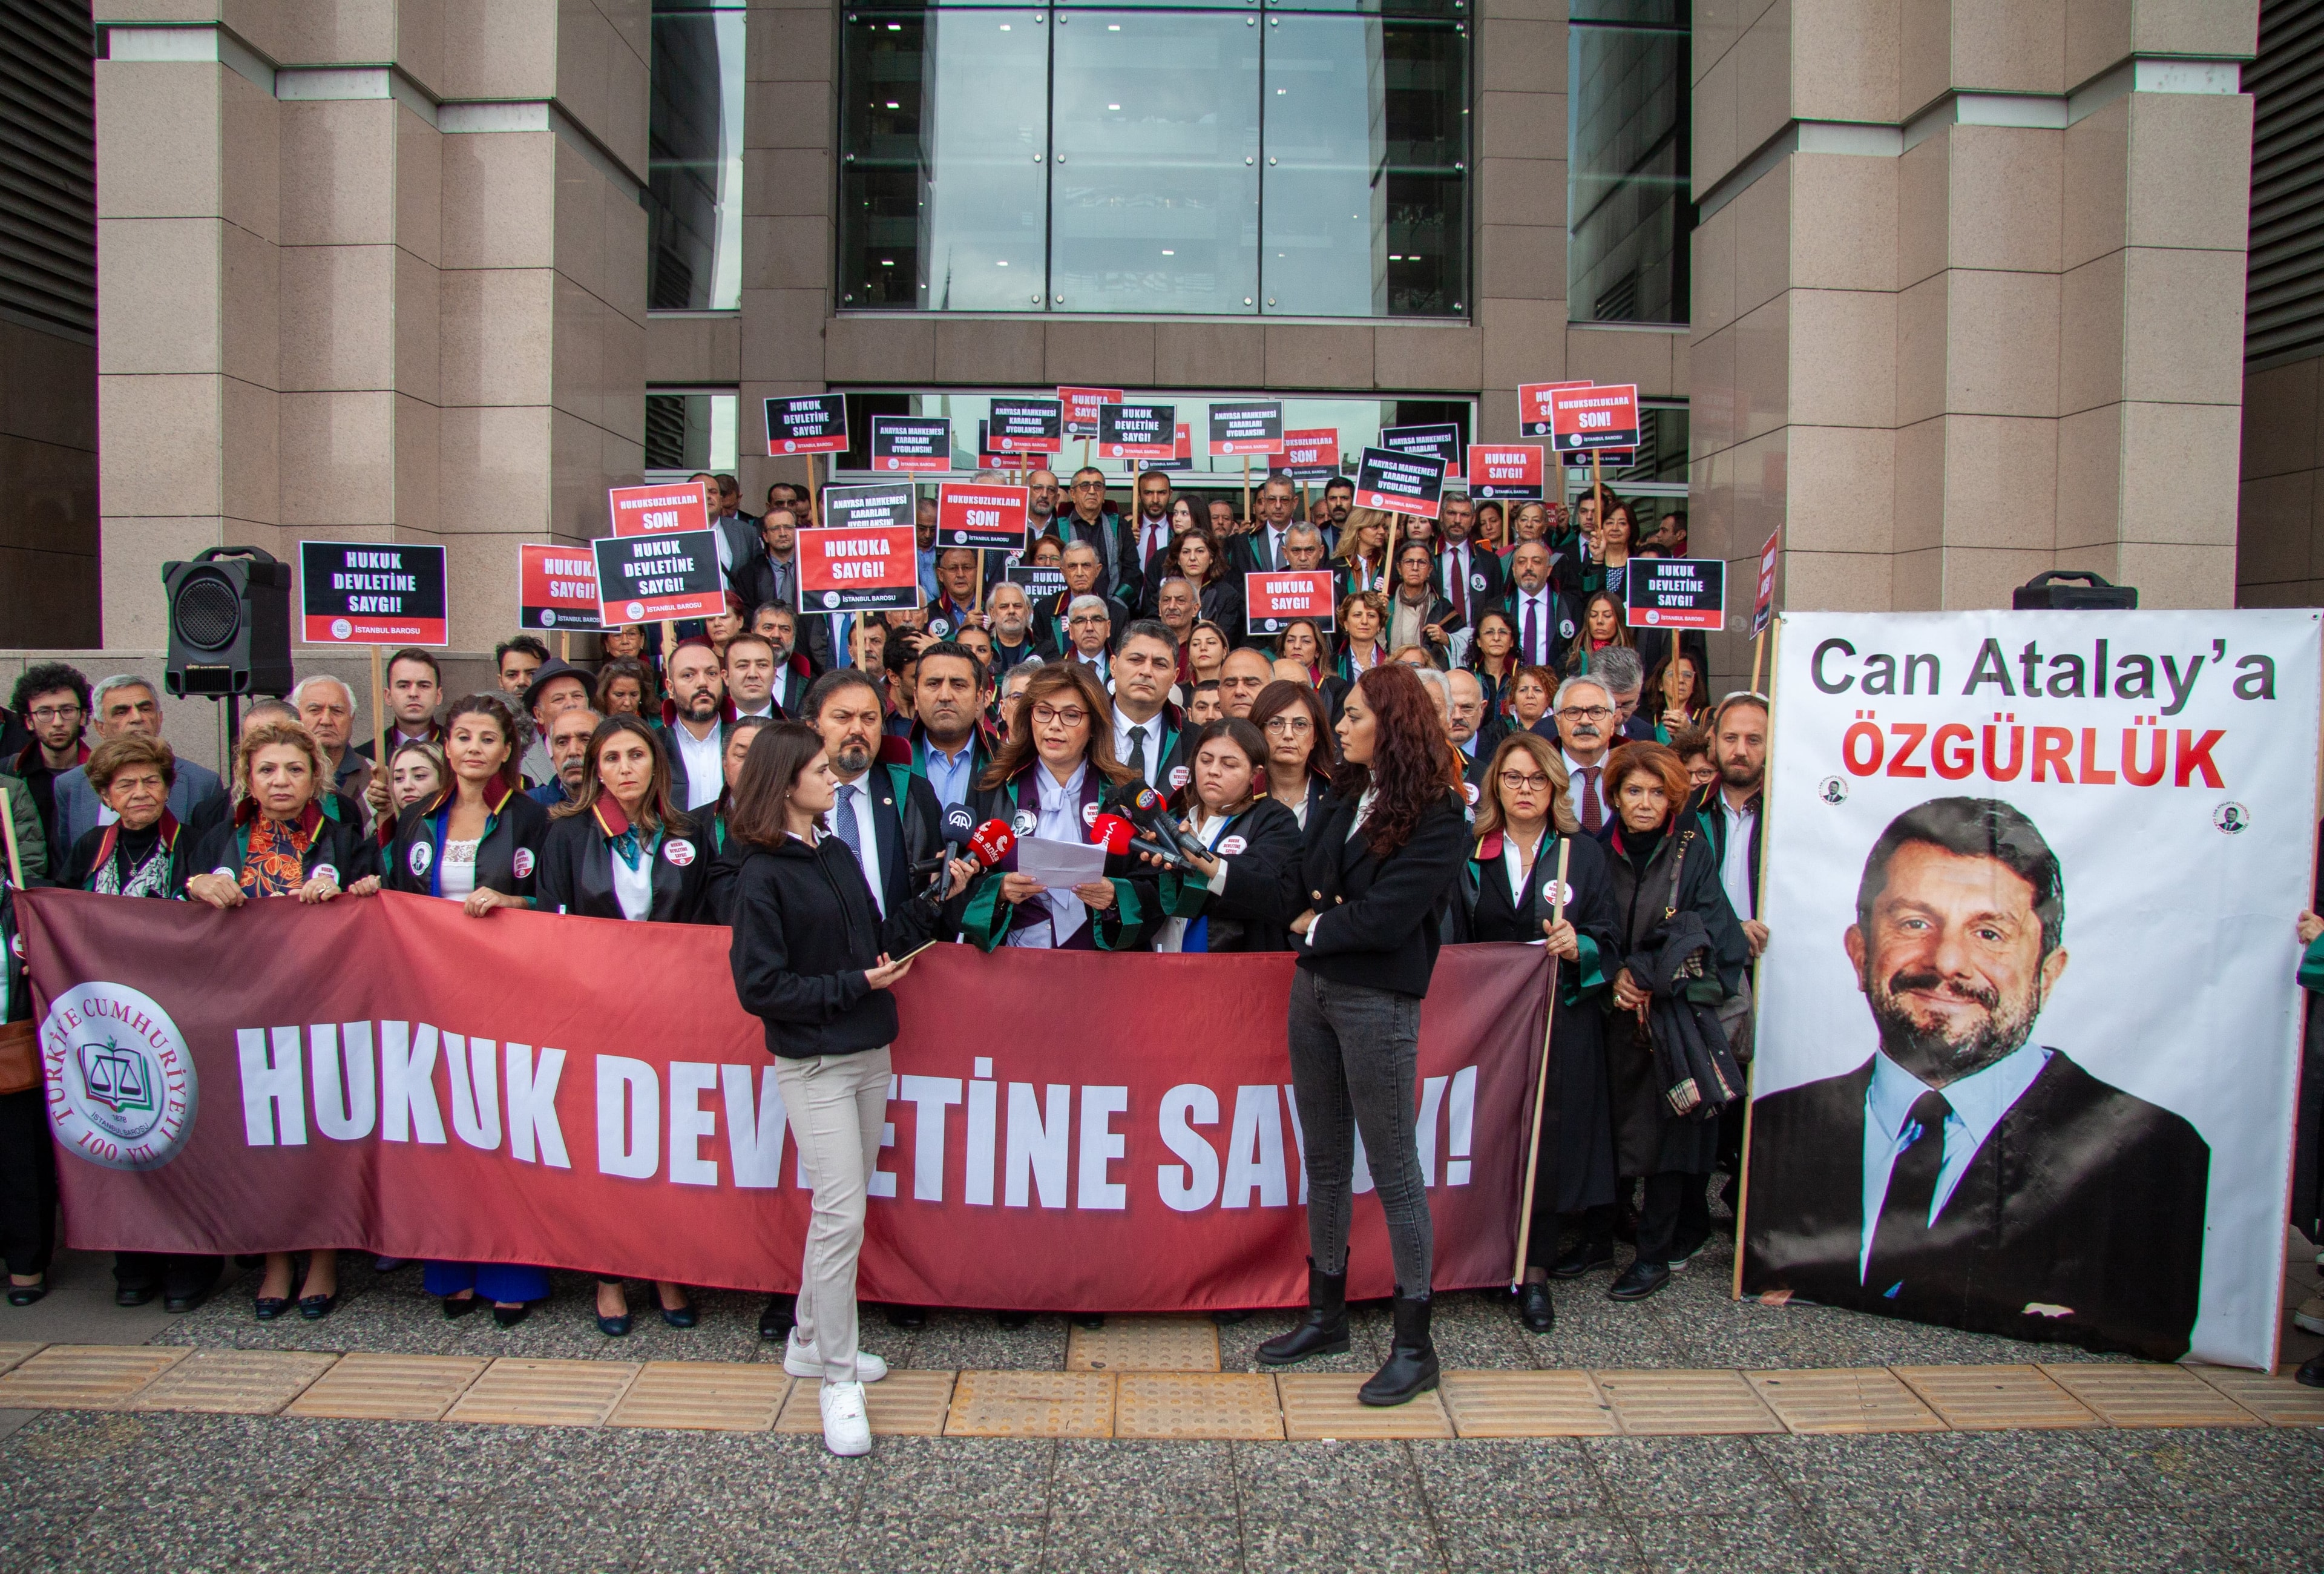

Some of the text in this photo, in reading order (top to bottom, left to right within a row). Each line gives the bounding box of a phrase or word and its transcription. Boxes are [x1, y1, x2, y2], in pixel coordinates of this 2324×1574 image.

[790, 400, 821, 412] HUKUK
[1558, 397, 1629, 410] HUKUKSUZLUKLARA
[783, 412, 830, 424] DEVLETİNE
[1022, 408, 1056, 417] MAHKEMESİ
[1075, 407, 1097, 418] SAYG
[1122, 409, 1152, 418] HUKUK
[1215, 410, 1276, 420] ANAYASA MAHKEMESİ
[1009, 417, 1042, 426] KARARLARI
[1115, 420, 1159, 431] DEVLETİNE
[1578, 412, 1611, 428] SON!
[793, 425, 822, 436] SAYGI!
[880, 426, 945, 436] ANAYASA MAHKEMESİ
[1006, 426, 1045, 434] UYGULANSIN!
[1226, 429, 1265, 438] UYGULANSIN!
[1122, 432, 1151, 442] SAYGI!
[1284, 437, 1333, 446] UKSUZLUKLARA
[1389, 433, 1451, 446] ANAYASA MAHKEMESİ
[891, 445, 933, 453] UYGULANSIN!
[1404, 444, 1437, 453] KARARLARI
[1290, 450, 1318, 463] SON!
[1485, 453, 1527, 464] HUKUKA
[1368, 459, 1437, 478] ANAYASA MAHKEMESİ
[1489, 467, 1523, 478] SAYGI!
[1382, 471, 1420, 484] KARARLARI
[1377, 480, 1422, 495] UYGULANSIN!
[620, 495, 698, 510] HUKUKSUZLUKLARA
[833, 494, 907, 509] ANAYASA MAHKEMESİ
[947, 495, 1020, 507] HUKUKSUZLUKLARA
[642, 511, 678, 529] SON!
[850, 508, 890, 519] KARARLARI
[966, 510, 1000, 527] SON!
[633, 540, 681, 558] HUKUK
[825, 539, 890, 558] HUKUKA
[346, 552, 402, 569] HUKUK
[623, 556, 695, 578] DEVLETİNE
[832, 561, 885, 579] SAYGI!
[1657, 565, 1695, 576] HUKUK
[333, 572, 416, 591] DEVLETİNE
[639, 578, 684, 596] SAYGI!
[1266, 581, 1314, 594] HUKUKA
[1649, 578, 1704, 592] DEVLETİNE
[550, 581, 596, 599] SAYGI!
[349, 595, 402, 613] SAYGI!
[842, 594, 872, 603] İSTANBUL
[1272, 597, 1310, 610] SAYGI!
[1658, 594, 1693, 607] SAYGI!
[646, 602, 702, 613] İSTANBUL BAROSU
[557, 614, 582, 623] İSTANBUL
[355, 625, 390, 634] İSTANBUL
[390, 627, 421, 635] BAROSU
[1810, 637, 1940, 696] Can
[1842, 710, 2227, 789] ÖZGÜRLÜK
[950, 814, 969, 830] AA
[984, 842, 999, 861] anka
[83, 998, 187, 1145] CUMHURİYETİ
[111, 1114, 128, 1123] 1878
[235, 1019, 1477, 1211] HUKUK DEVTİNE SAI!
[91, 1111, 149, 1136] İSTANBUL BAROSU
[125, 1143, 161, 1165] YIL
